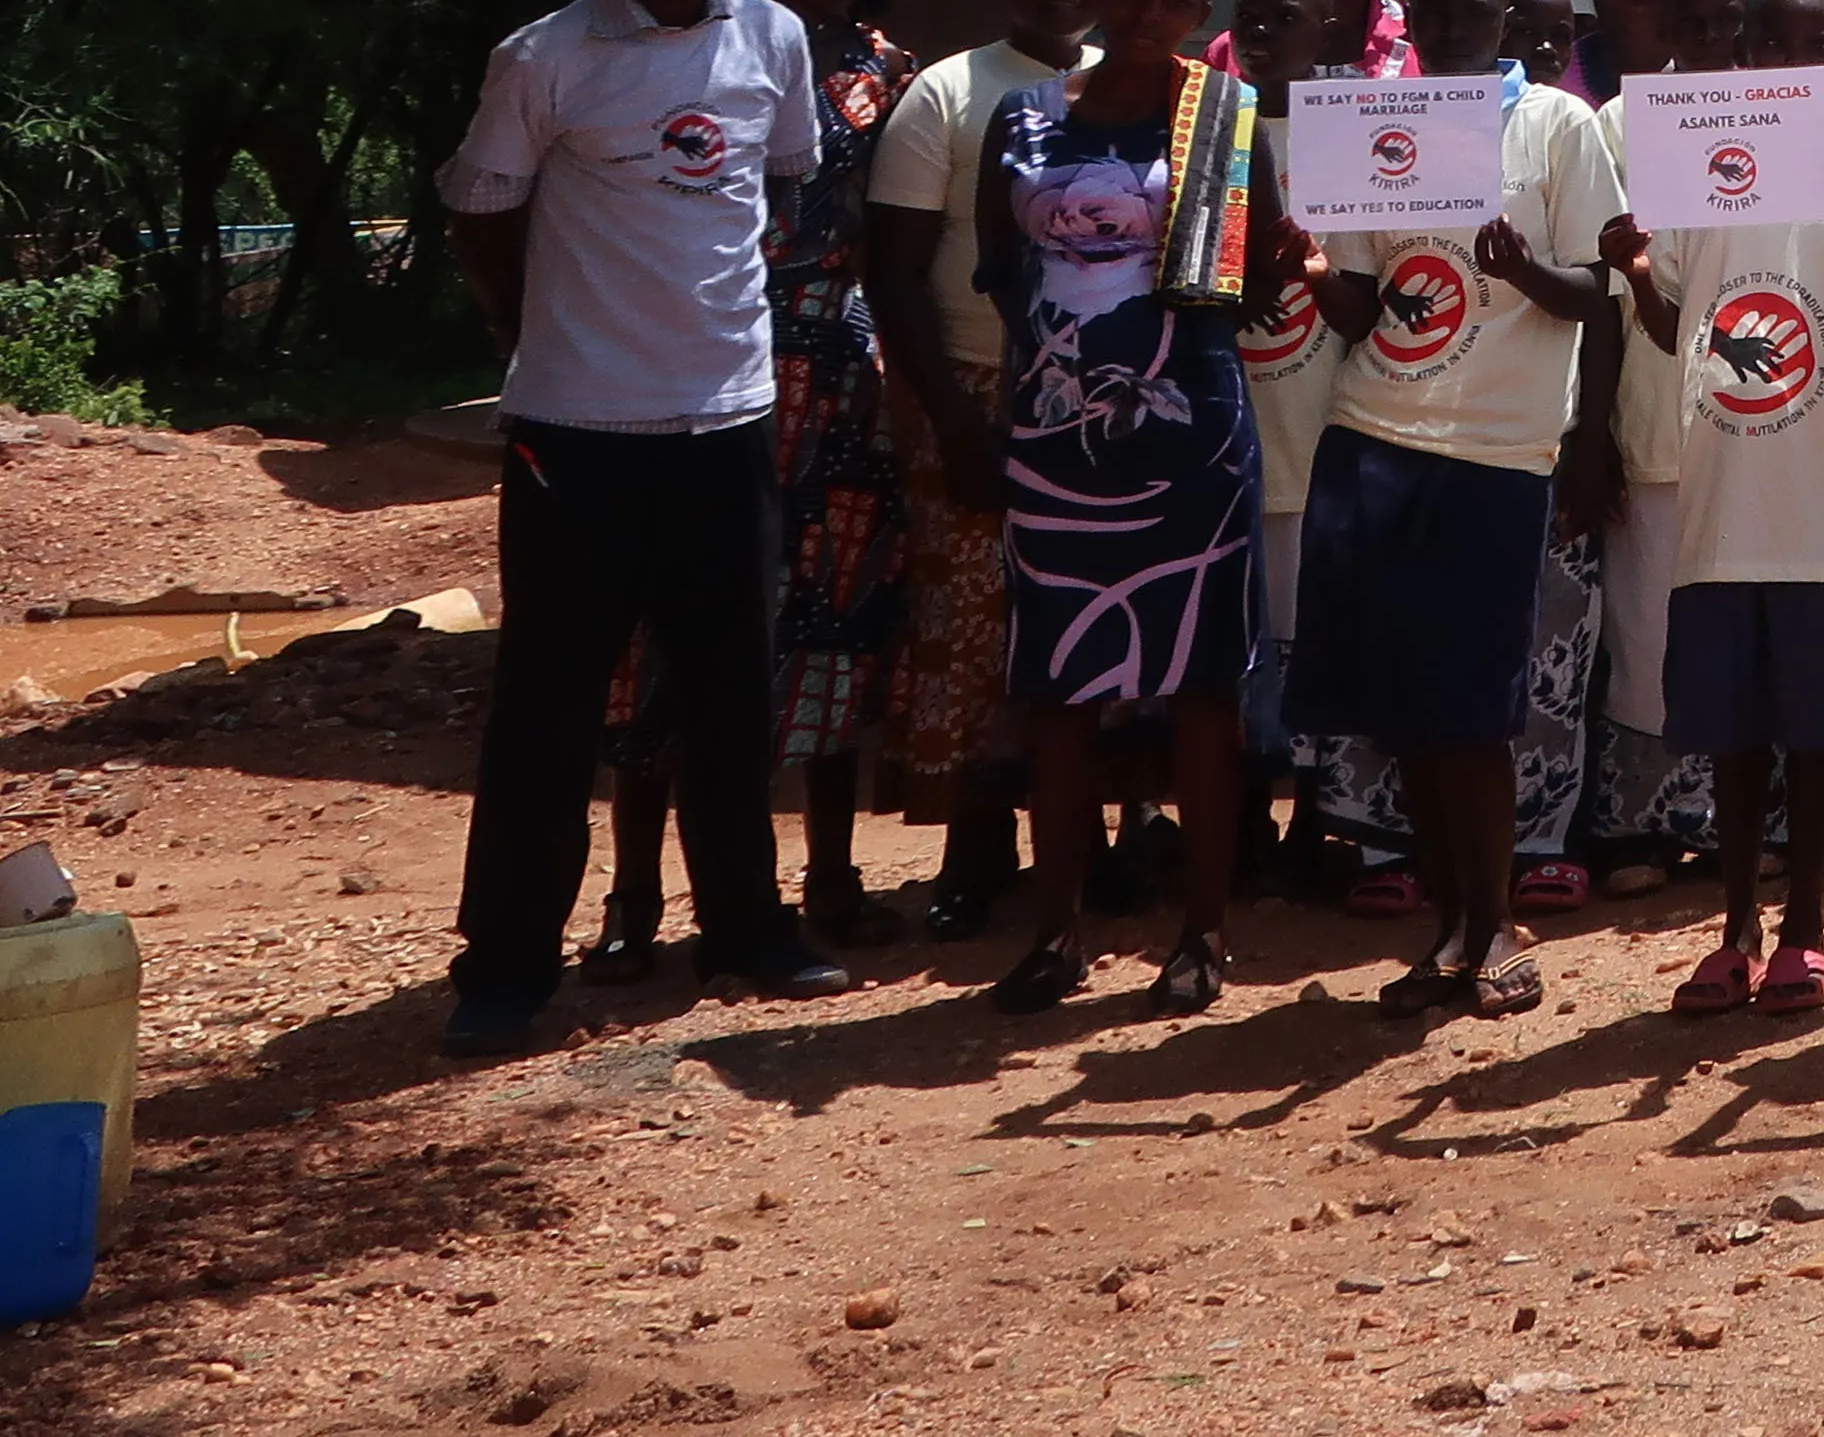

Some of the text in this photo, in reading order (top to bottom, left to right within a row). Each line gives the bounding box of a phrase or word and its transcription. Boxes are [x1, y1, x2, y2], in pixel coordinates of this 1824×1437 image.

[1304, 90, 1485, 106] WE SAY NO TO FGM & CHILD
[1647, 92, 1695, 106] THANK
[1700, 91, 1731, 103] YOU
[1745, 85, 1811, 101] GRACIAS
[1359, 104, 1427, 116] MARRIAGE
[1679, 113, 1781, 129] ASANTE SANA
[1368, 173, 1421, 191] KIRIRA
[1306, 198, 1484, 215] WE SAY YES TO EDUCATION
[1706, 193, 1762, 212] KIRIRA
[1431, 237, 1451, 250] THE
[1749, 272, 1762, 283] TO
[1765, 272, 1785, 285] THE
